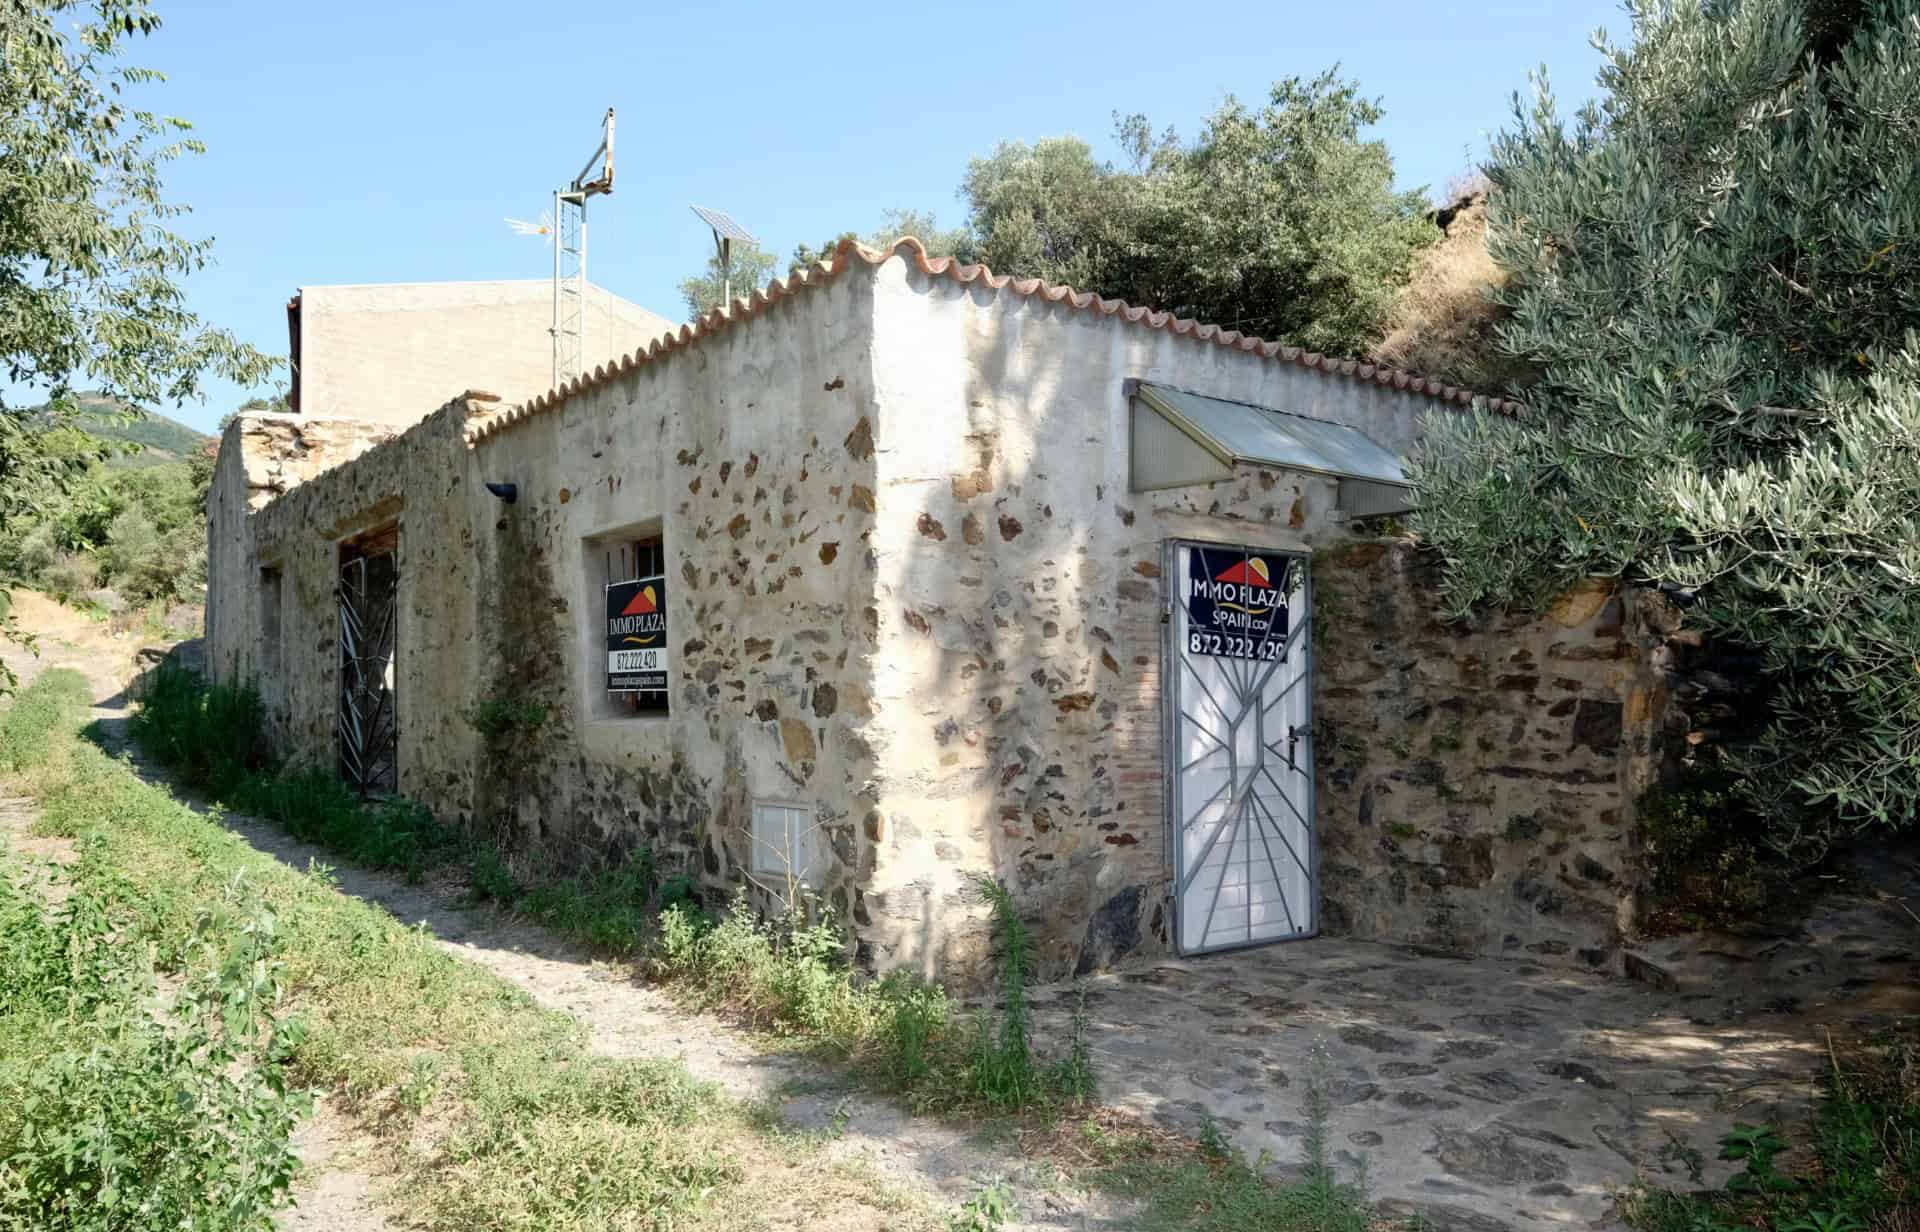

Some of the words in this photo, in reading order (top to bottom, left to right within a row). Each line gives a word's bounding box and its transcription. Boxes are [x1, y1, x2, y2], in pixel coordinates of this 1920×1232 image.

[1239, 585, 1288, 609] PLAZA
[610, 616, 635, 635] IMMO
[636, 613, 665, 633] PLAZA
[1190, 633, 1221, 655] 872
[1225, 636, 1253, 658] 222
